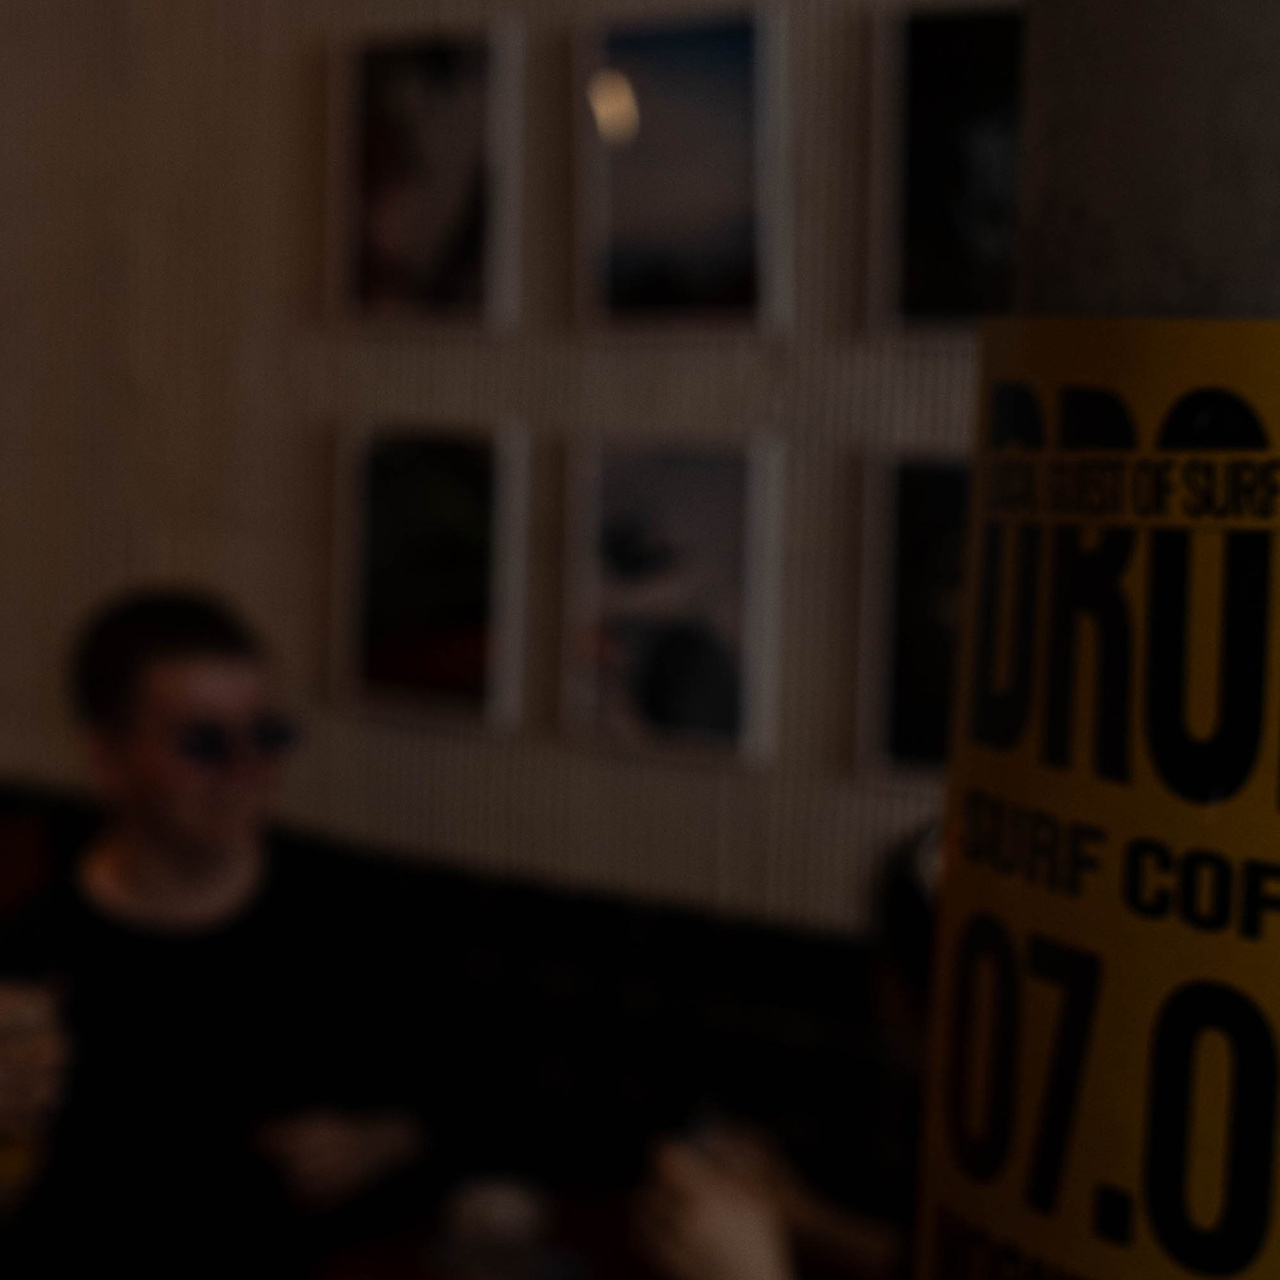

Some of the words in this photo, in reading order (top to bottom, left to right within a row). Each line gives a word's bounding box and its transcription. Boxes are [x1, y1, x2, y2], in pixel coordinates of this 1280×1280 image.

[974, 380, 1280, 803] DRO
[1132, 460, 1175, 517] OF
[963, 787, 1107, 900] SURF
[1121, 836, 1280, 941] COF
[949, 910, 1276, 1278] 07.0
